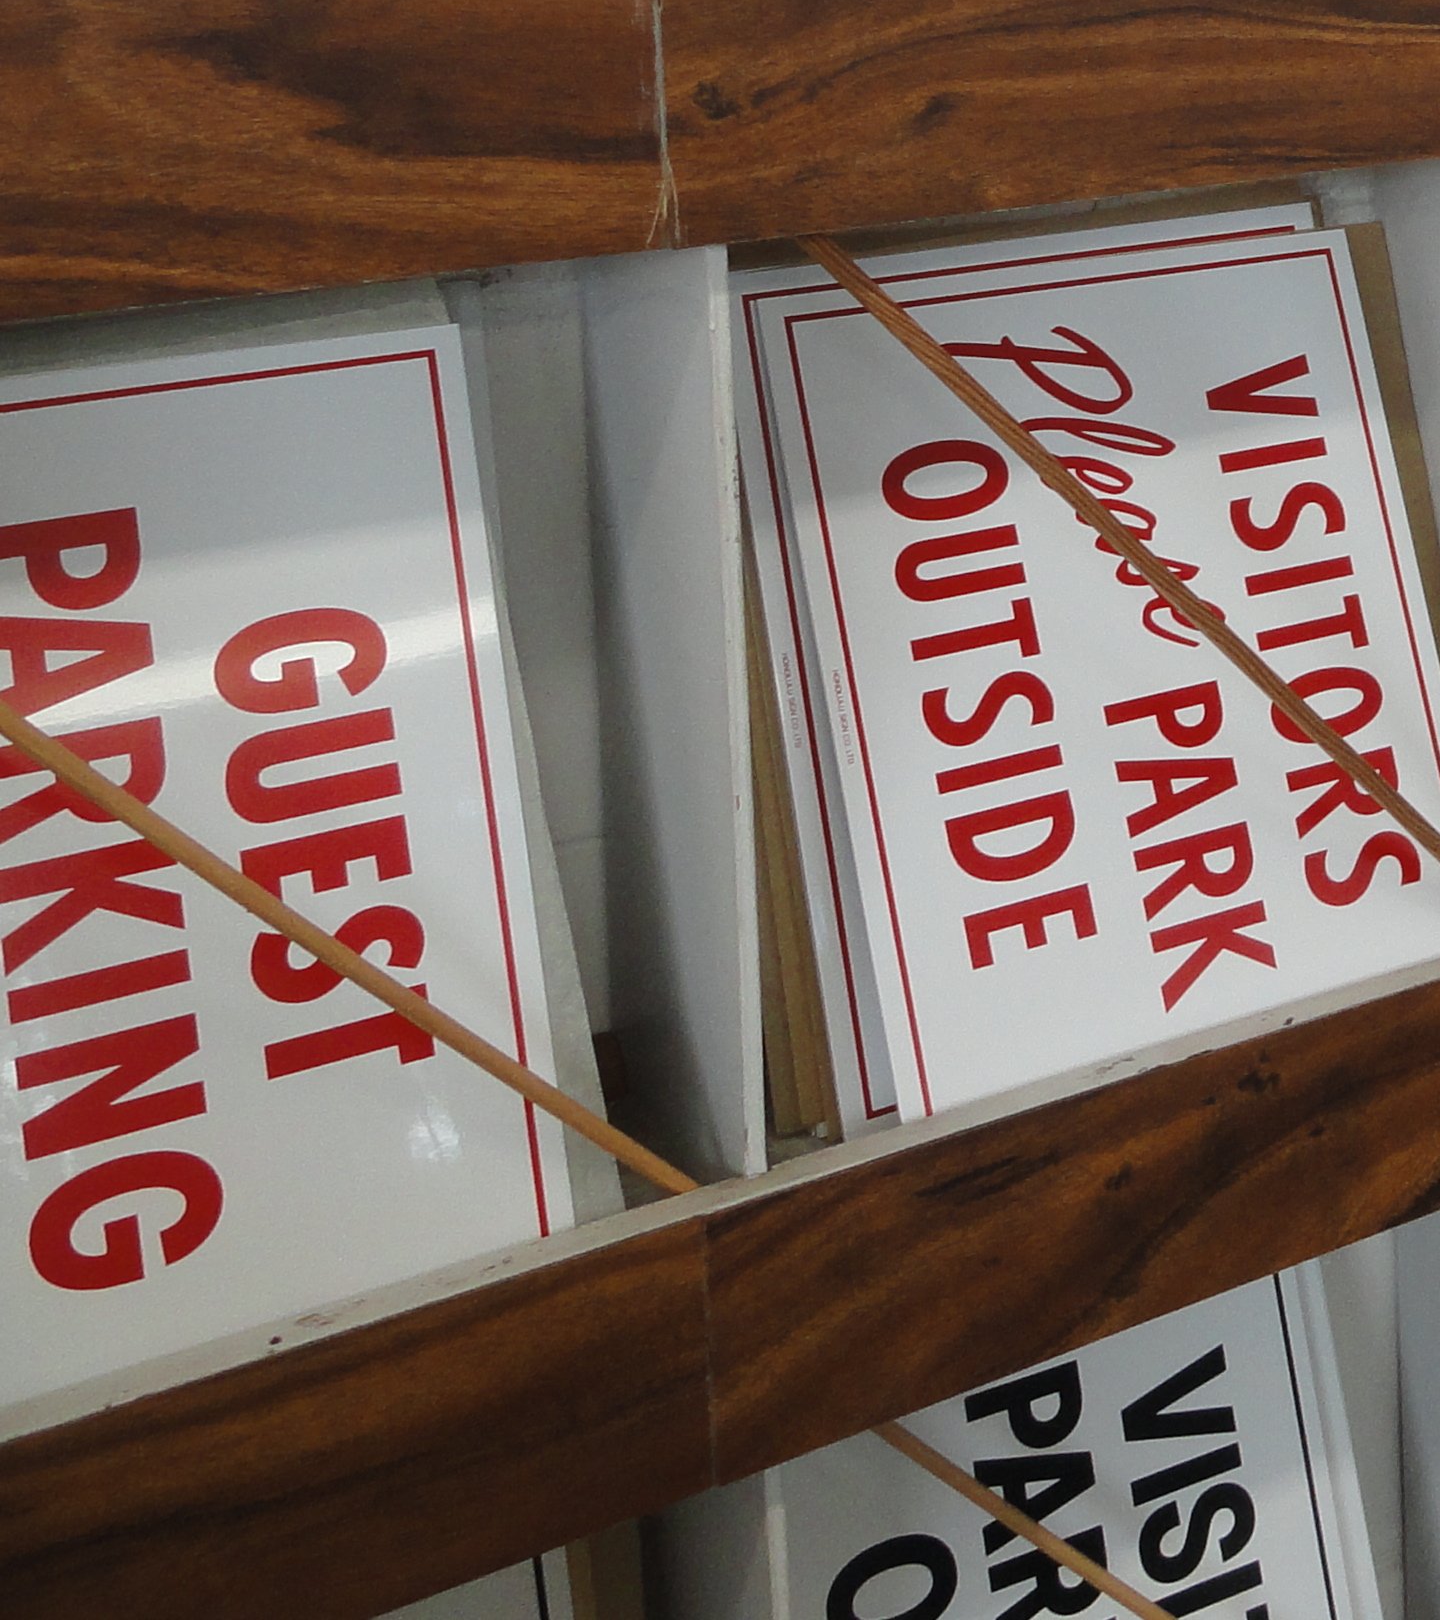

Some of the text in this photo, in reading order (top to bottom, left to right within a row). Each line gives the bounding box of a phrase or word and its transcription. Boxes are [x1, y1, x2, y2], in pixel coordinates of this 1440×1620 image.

[213, 607, 437, 1082] GUEST
[881, 439, 1099, 970] OUTSIDE
[1102, 680, 1279, 1014] PARK
[1203, 352, 1423, 908] VISITORS
[0, 506, 225, 1292] PARKING
